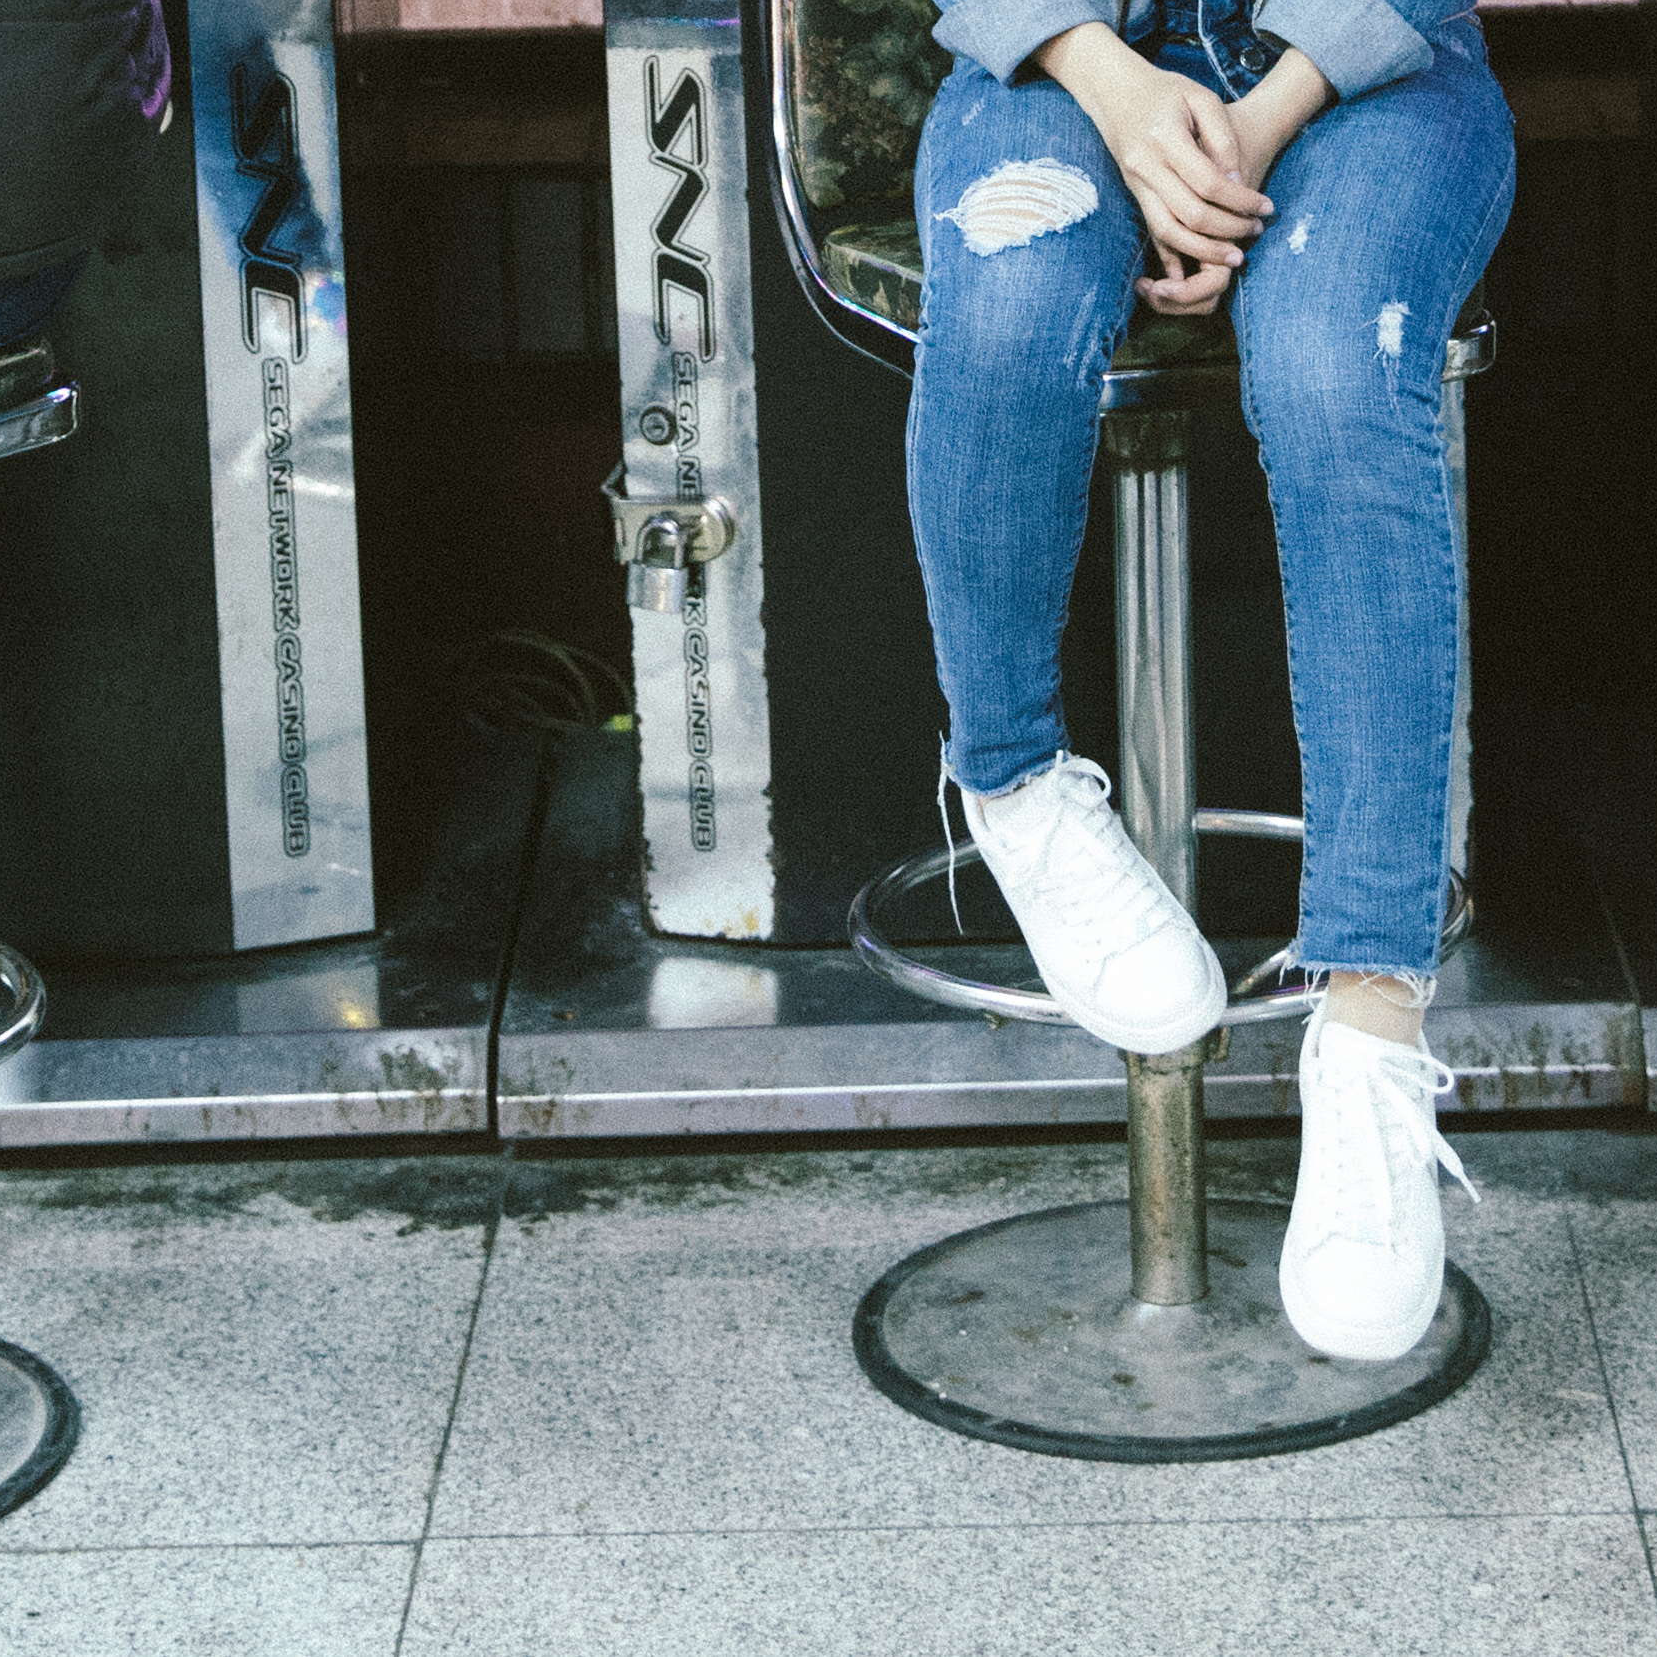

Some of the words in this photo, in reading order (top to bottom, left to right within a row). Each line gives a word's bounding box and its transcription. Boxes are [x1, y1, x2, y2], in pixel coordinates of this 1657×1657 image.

[643, 55, 716, 363] SNC
[262, 357, 292, 460] SEGA
[672, 351, 699, 453] SEGA
[267, 459, 301, 632] NETWORK
[275, 631, 306, 765] CASINO
[683, 627, 713, 759] CASINO
[281, 764, 310, 858] CLUB
[689, 759, 717, 852] CLUB
